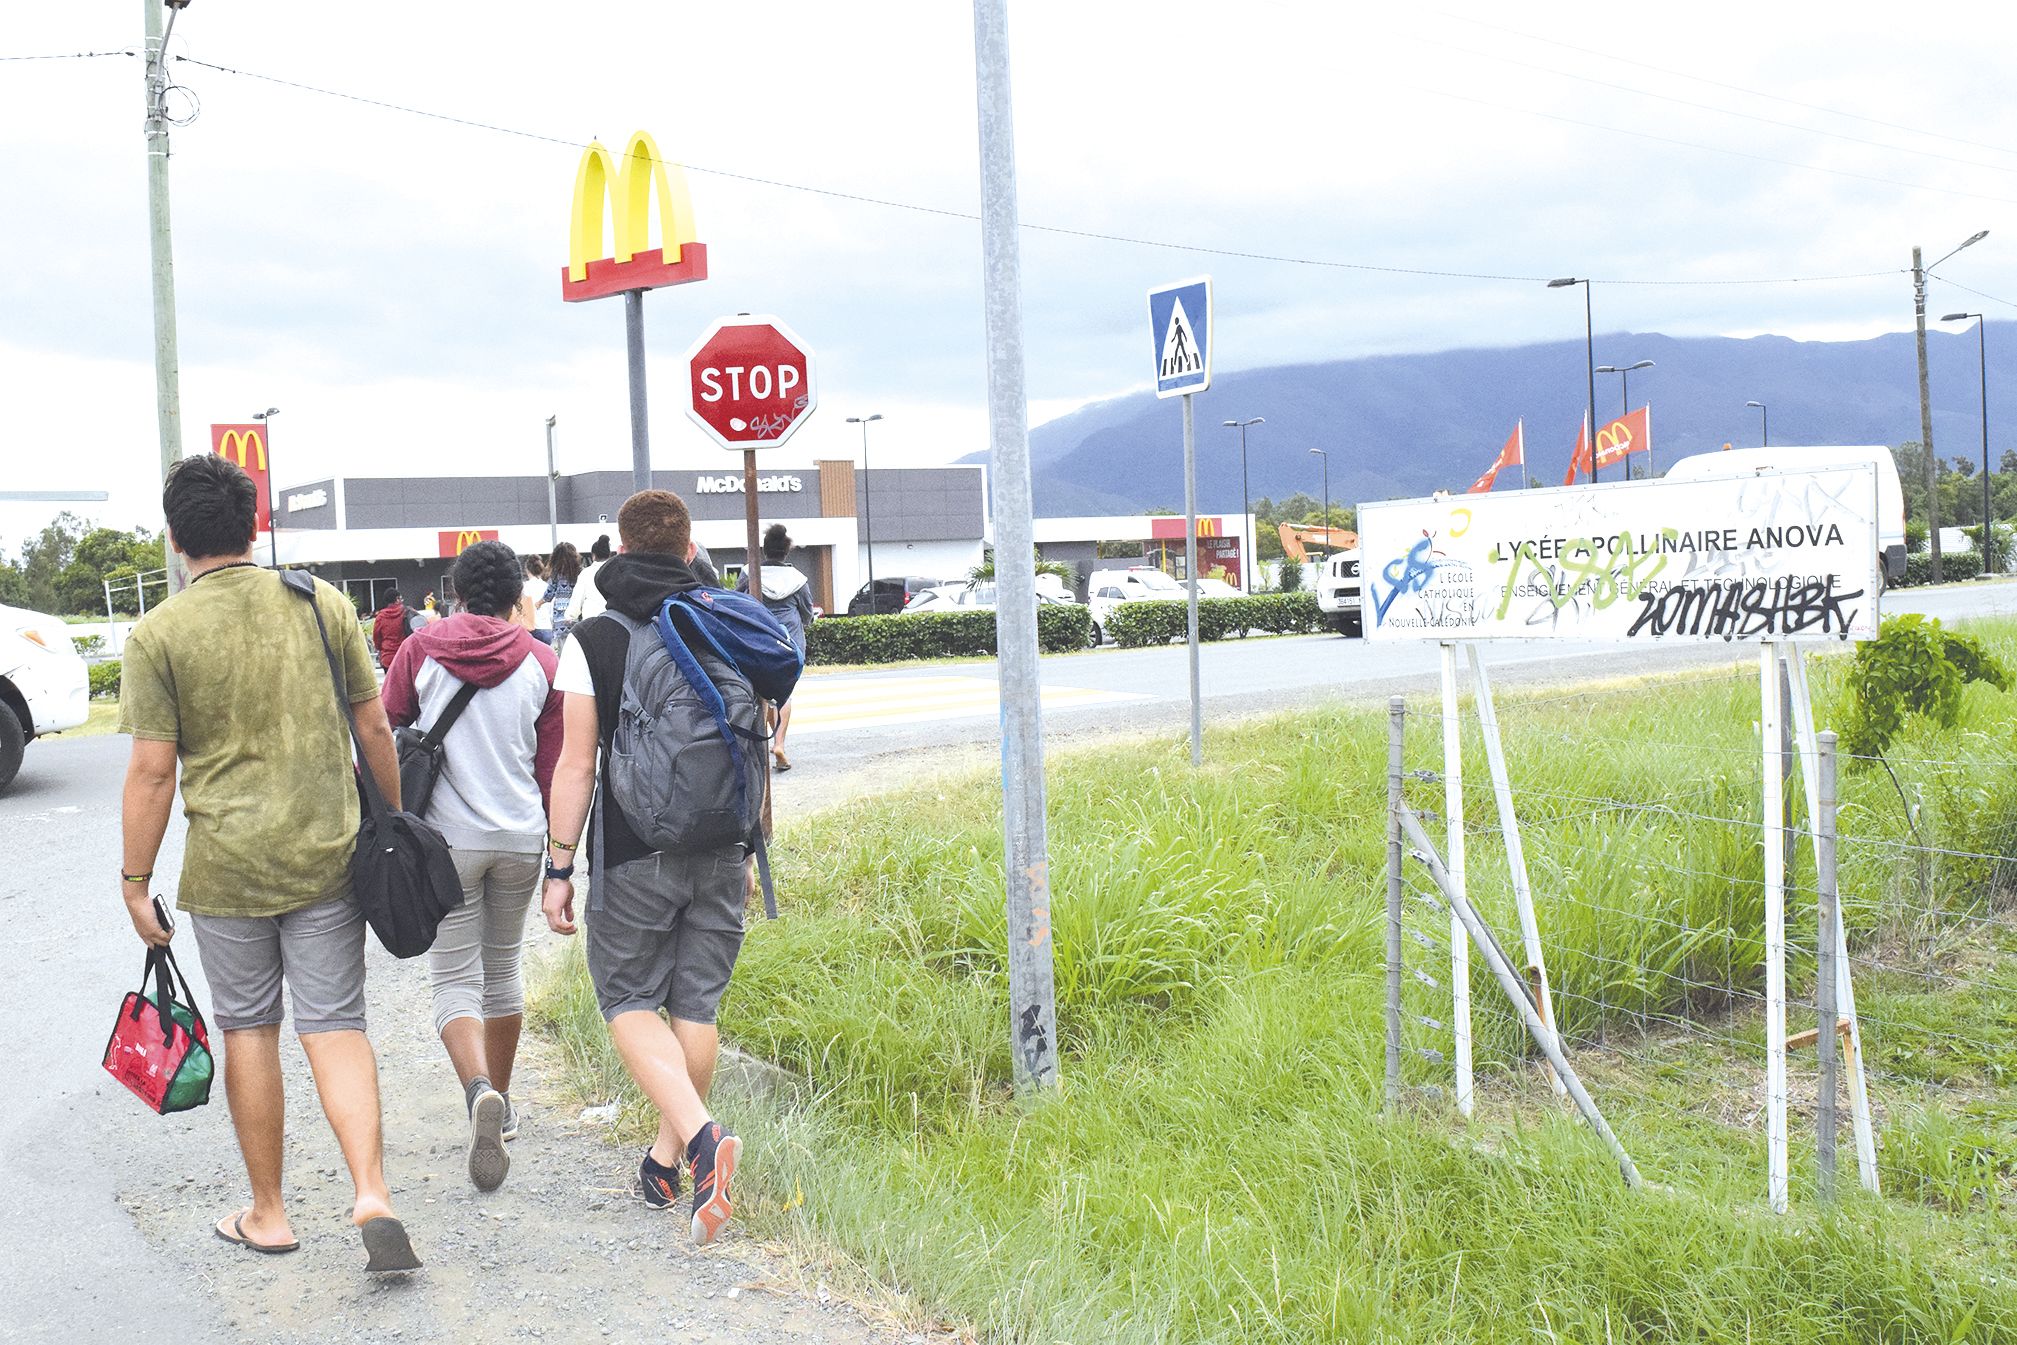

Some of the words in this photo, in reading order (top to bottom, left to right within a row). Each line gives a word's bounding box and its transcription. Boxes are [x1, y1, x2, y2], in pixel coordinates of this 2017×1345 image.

[700, 364, 800, 402] STOP
[696, 476, 802, 494] McDald's
[1496, 534, 1567, 561] LYCÉE
[1746, 523, 1845, 549] ANOVA
[1418, 587, 1474, 599] CATHOLIQUE
[1501, 580, 1606, 598] ENSEIGNEEN
[1463, 602, 1474, 612] EN
